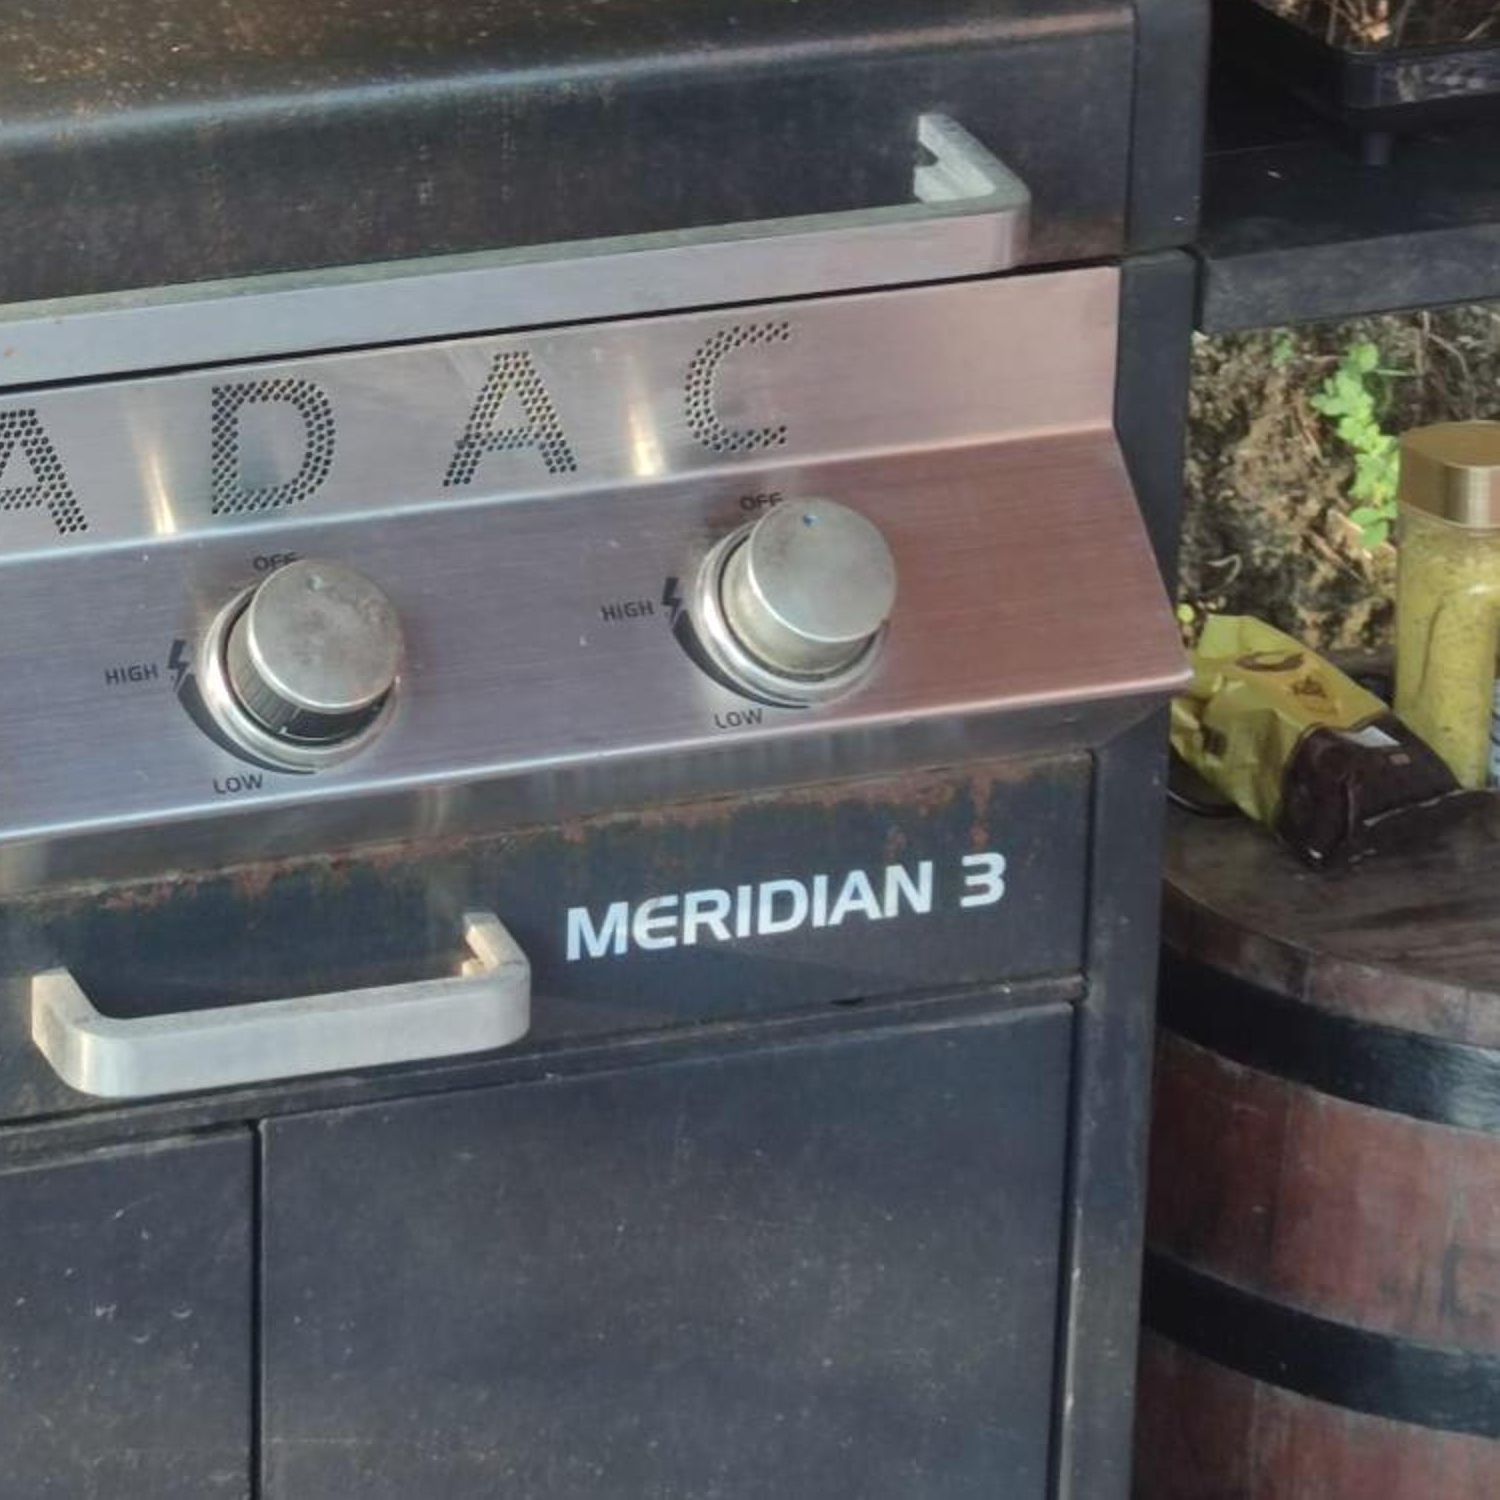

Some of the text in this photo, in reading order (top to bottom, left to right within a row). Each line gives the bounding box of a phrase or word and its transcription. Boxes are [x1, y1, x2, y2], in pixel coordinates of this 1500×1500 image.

[601, 600, 655, 622] HIGH
[104, 663, 159, 686] HIGH
[714, 708, 763, 729] LOW
[213, 774, 263, 794] LOW
[565, 851, 1006, 961] MERIDIAN 3
